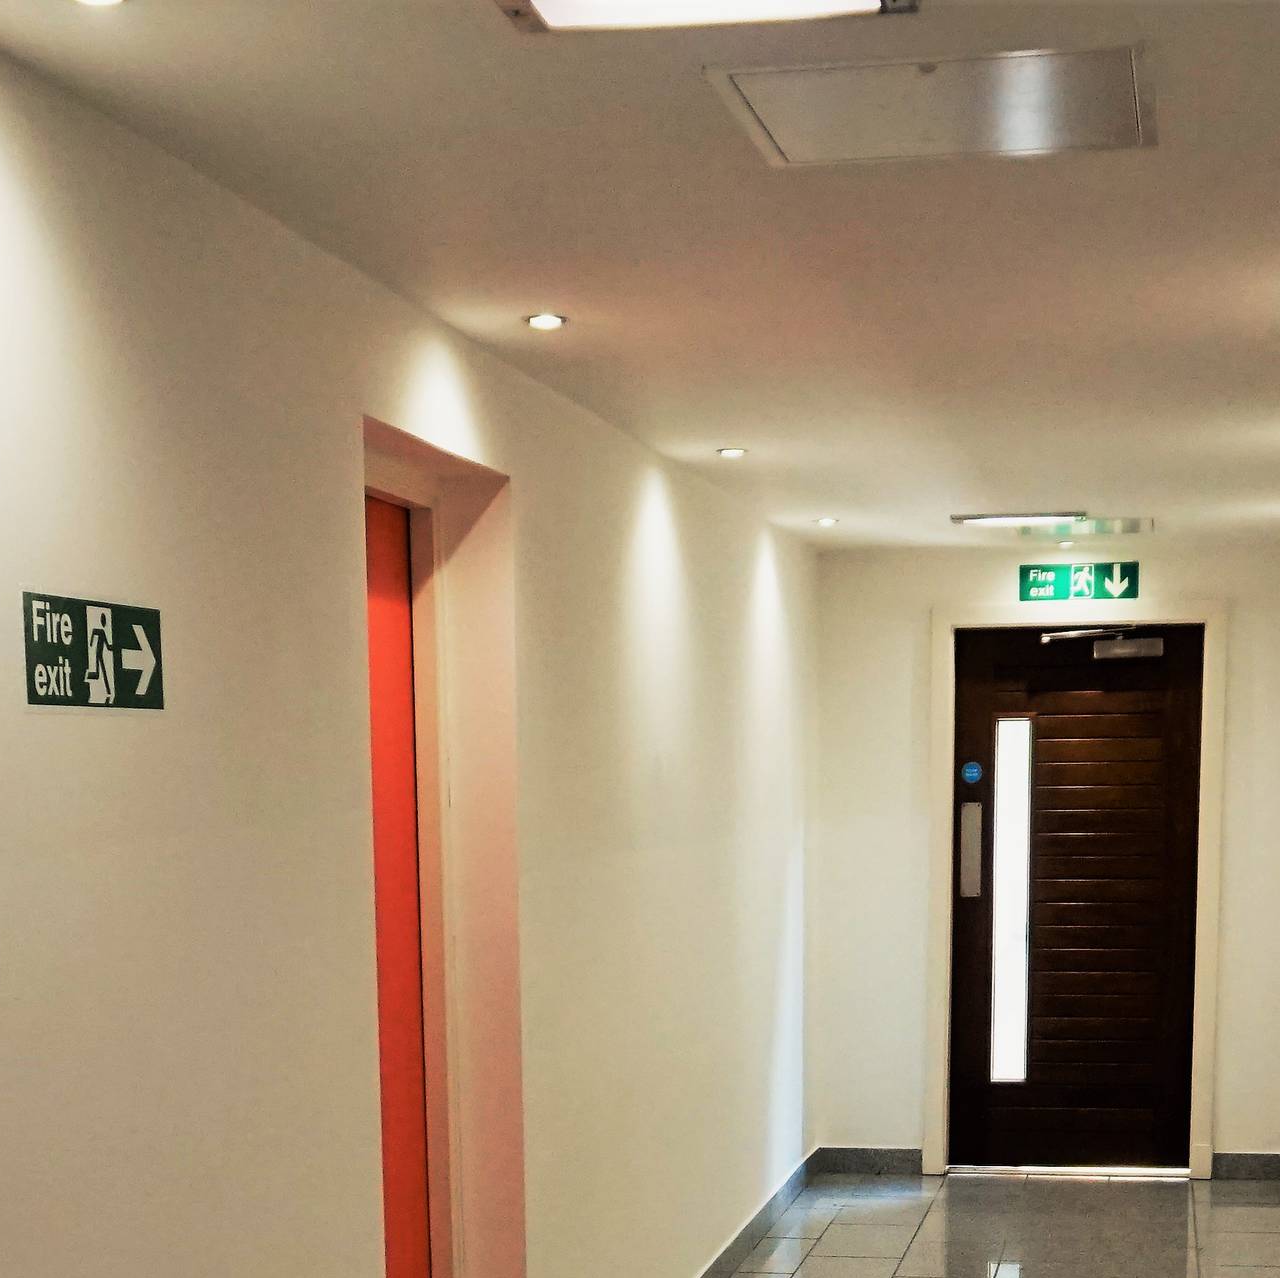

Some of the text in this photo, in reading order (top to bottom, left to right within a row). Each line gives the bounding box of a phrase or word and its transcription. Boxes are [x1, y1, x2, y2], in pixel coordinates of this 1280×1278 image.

[1029, 569, 1055, 581] Fire
[1029, 584, 1055, 597] exit
[32, 600, 73, 645] Fire
[34, 656, 73, 696] exit
